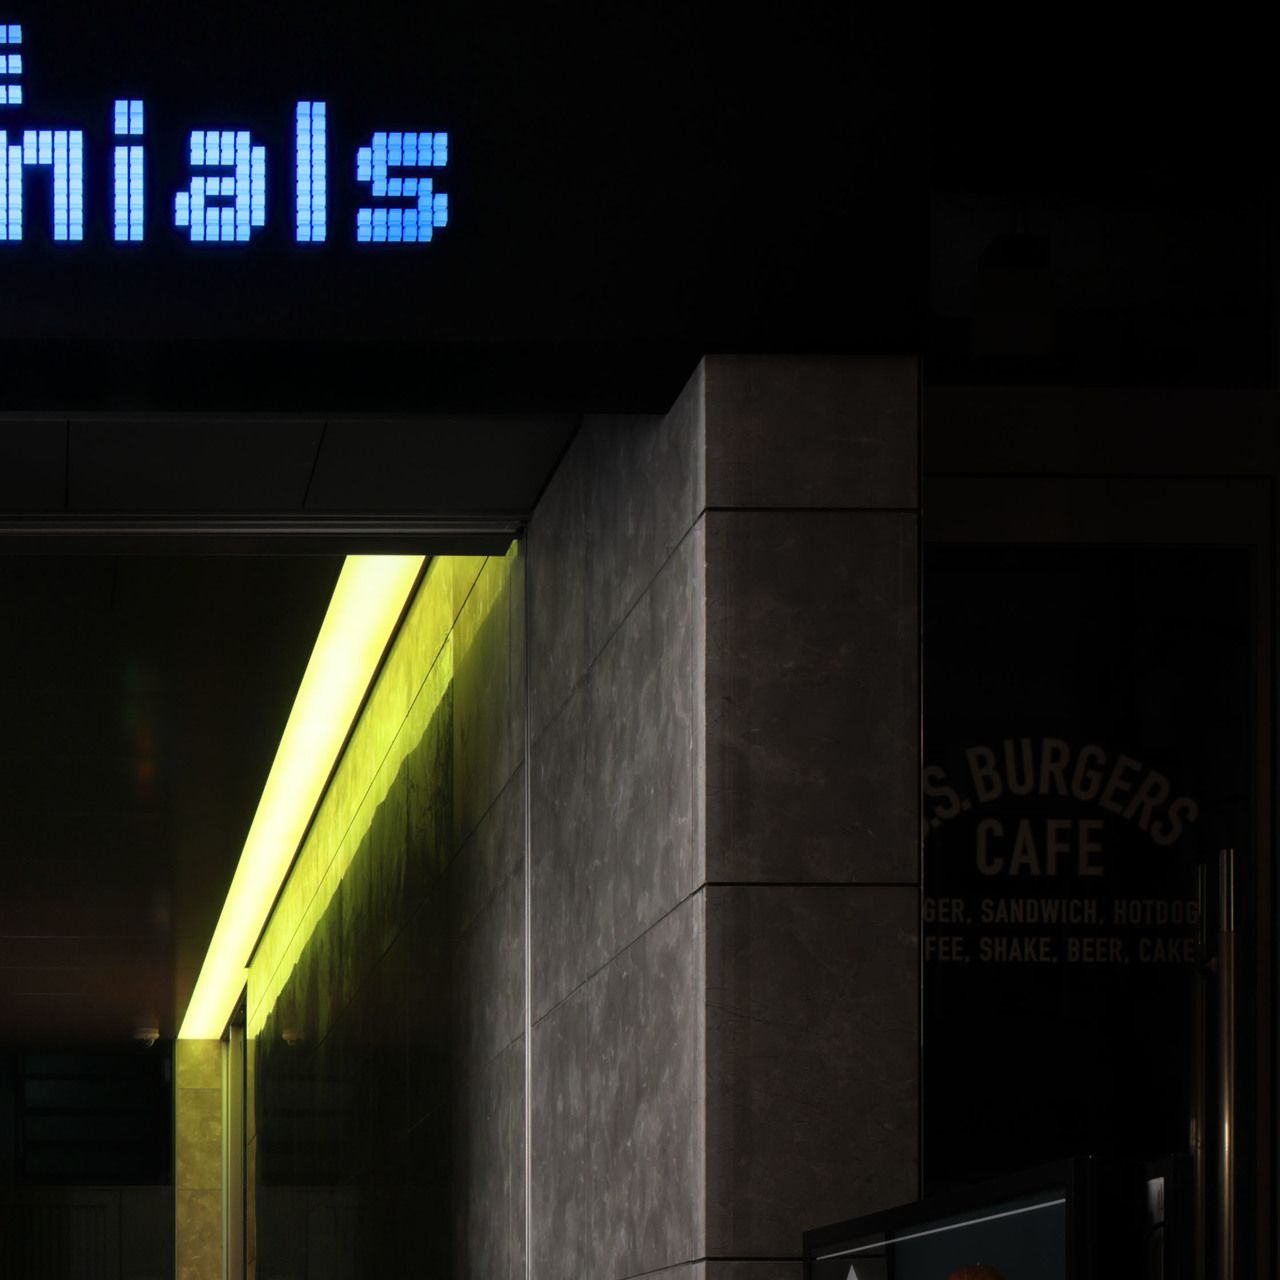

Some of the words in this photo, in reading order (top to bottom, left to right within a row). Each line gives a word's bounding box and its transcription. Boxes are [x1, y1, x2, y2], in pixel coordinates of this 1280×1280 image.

[965, 735, 1201, 848] BURGERS
[975, 816, 1106, 878] CAFE
[978, 936, 1059, 967] SHAKE,
